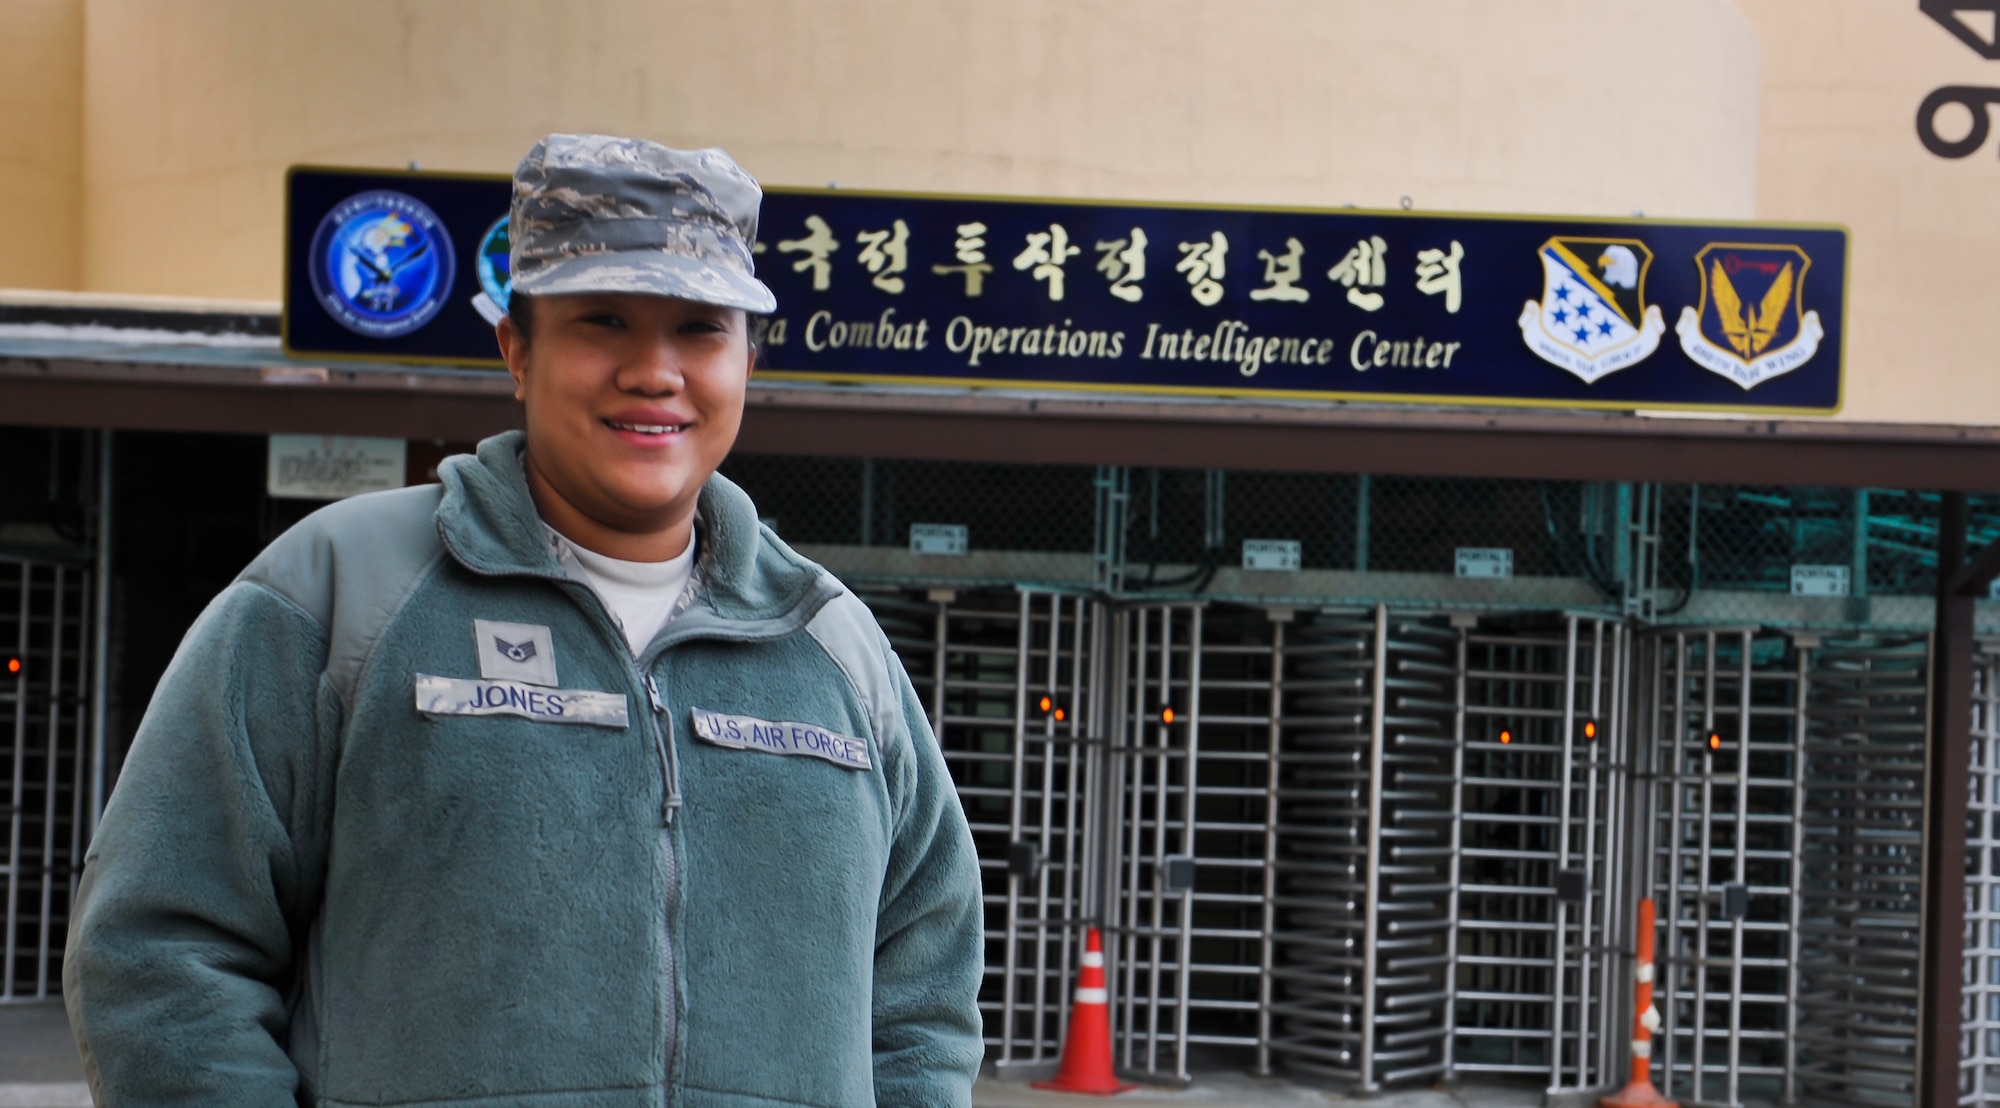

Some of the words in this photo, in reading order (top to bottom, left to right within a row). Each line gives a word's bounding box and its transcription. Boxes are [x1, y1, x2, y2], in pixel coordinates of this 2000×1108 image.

[752, 215, 1466, 314] 국전투작전정보센터
[805, 308, 929, 351] Combat
[945, 316, 1125, 366] Operations
[1140, 320, 1334, 377] Intelligence
[1350, 330, 1461, 372] Center
[469, 685, 564, 716] JONES
[706, 715, 747, 742] U.S.
[753, 723, 786, 749] AIR
[792, 727, 858, 762] FORCE
